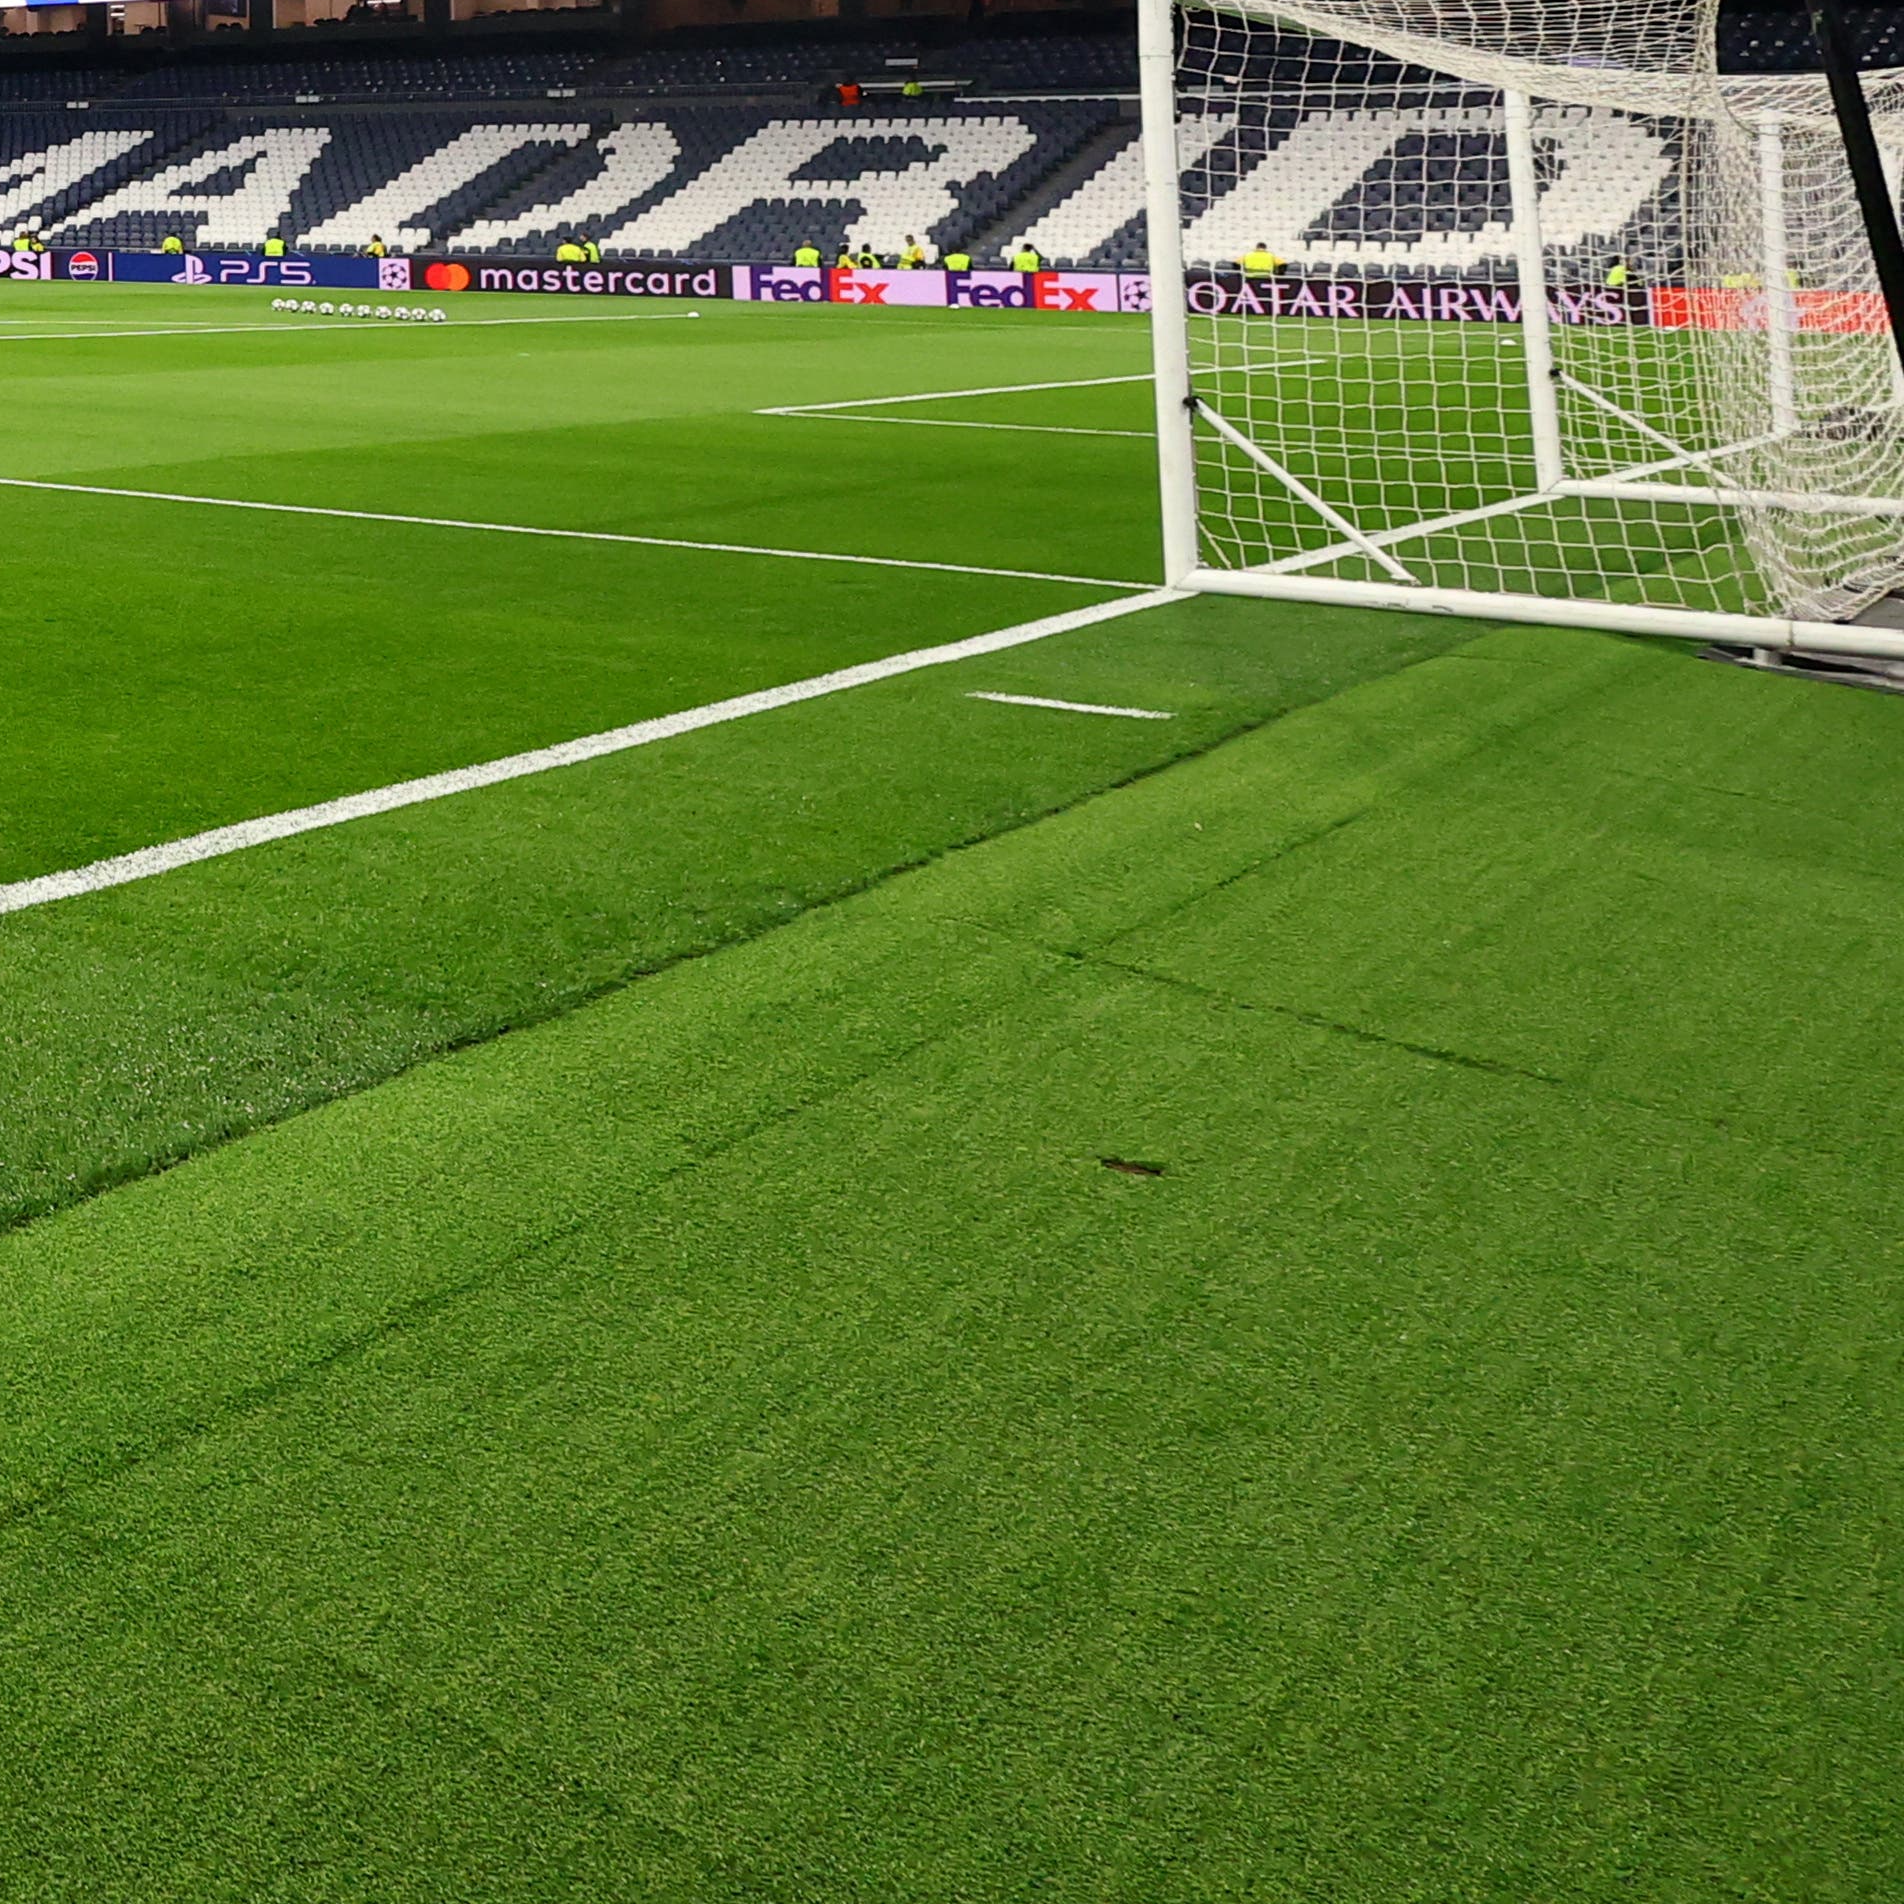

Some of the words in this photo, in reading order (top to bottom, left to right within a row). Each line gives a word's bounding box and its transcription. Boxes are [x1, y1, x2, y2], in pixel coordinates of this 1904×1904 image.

[219, 259, 312, 284] PS5
[480, 267, 717, 297] mastercard
[753, 268, 889, 305] FedEx
[947, 272, 1099, 311] FedEx
[1189, 282, 1360, 319] QATAR
[1384, 286, 1623, 326] AIRWYS
